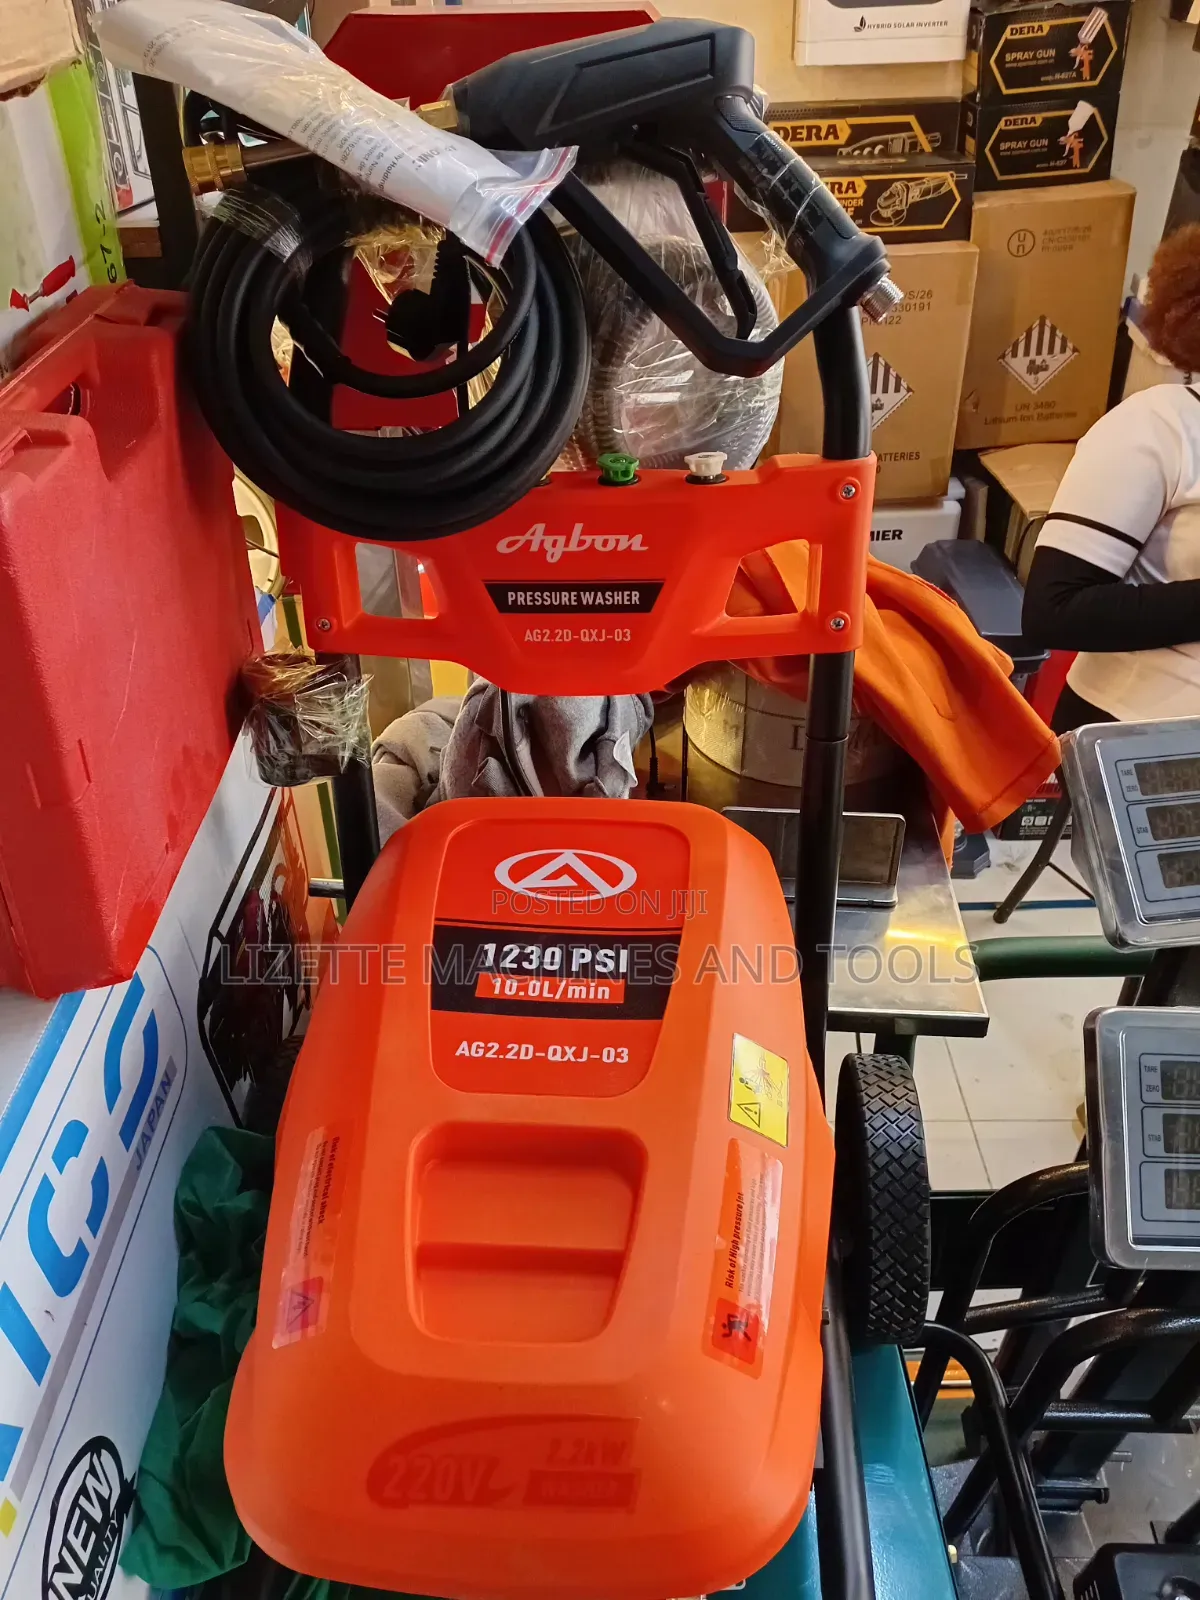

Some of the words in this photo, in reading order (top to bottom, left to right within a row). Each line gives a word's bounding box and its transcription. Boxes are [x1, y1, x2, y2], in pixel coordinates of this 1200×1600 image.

[893, 21, 914, 29] SOLAR
[916, 20, 948, 28] INVERTER
[1009, 24, 1044, 36] DERA
[1005, 50, 1034, 62] SPRAY
[1036, 48, 1056, 59] GUN
[1004, 116, 1037, 127] DERA
[773, 123, 840, 143] DERA
[1000, 140, 1028, 151] SPRAY
[1029, 138, 1049, 148] GUN
[1015, 402, 1030, 412] UN
[984, 415, 1017, 426] Lithium
[877, 451, 920, 463] ATTERIES
[496, 523, 649, 563] Agbon
[507, 591, 578, 606] PRESSURE
[580, 590, 641, 606] WASHER
[524, 628, 632, 643] AG2.2D-QXJ-03
[481, 942, 561, 972] 1230
[570, 946, 628, 973] PSI
[492, 977, 611, 1000] 10.0L/min
[455, 1040, 630, 1064] AG2.2D-QXJ-03
[1143, 1065, 1158, 1074] TARE
[1145, 1084, 1160, 1093] ZERO
[132, 1075, 174, 1171] JAPAN
[330, 1136, 340, 1154] Risk
[321, 1162, 334, 1200] electrical
[318, 1200, 328, 1225] shock
[733, 1206, 743, 1242] pressure
[729, 1240, 740, 1260] High
[729, 1257, 738, 1269] of
[725, 1269, 736, 1289] Risk
[382, 1453, 487, 1501] 220V
[49, 1452, 112, 1600] NEW
[84, 1508, 119, 1600] UALITY
